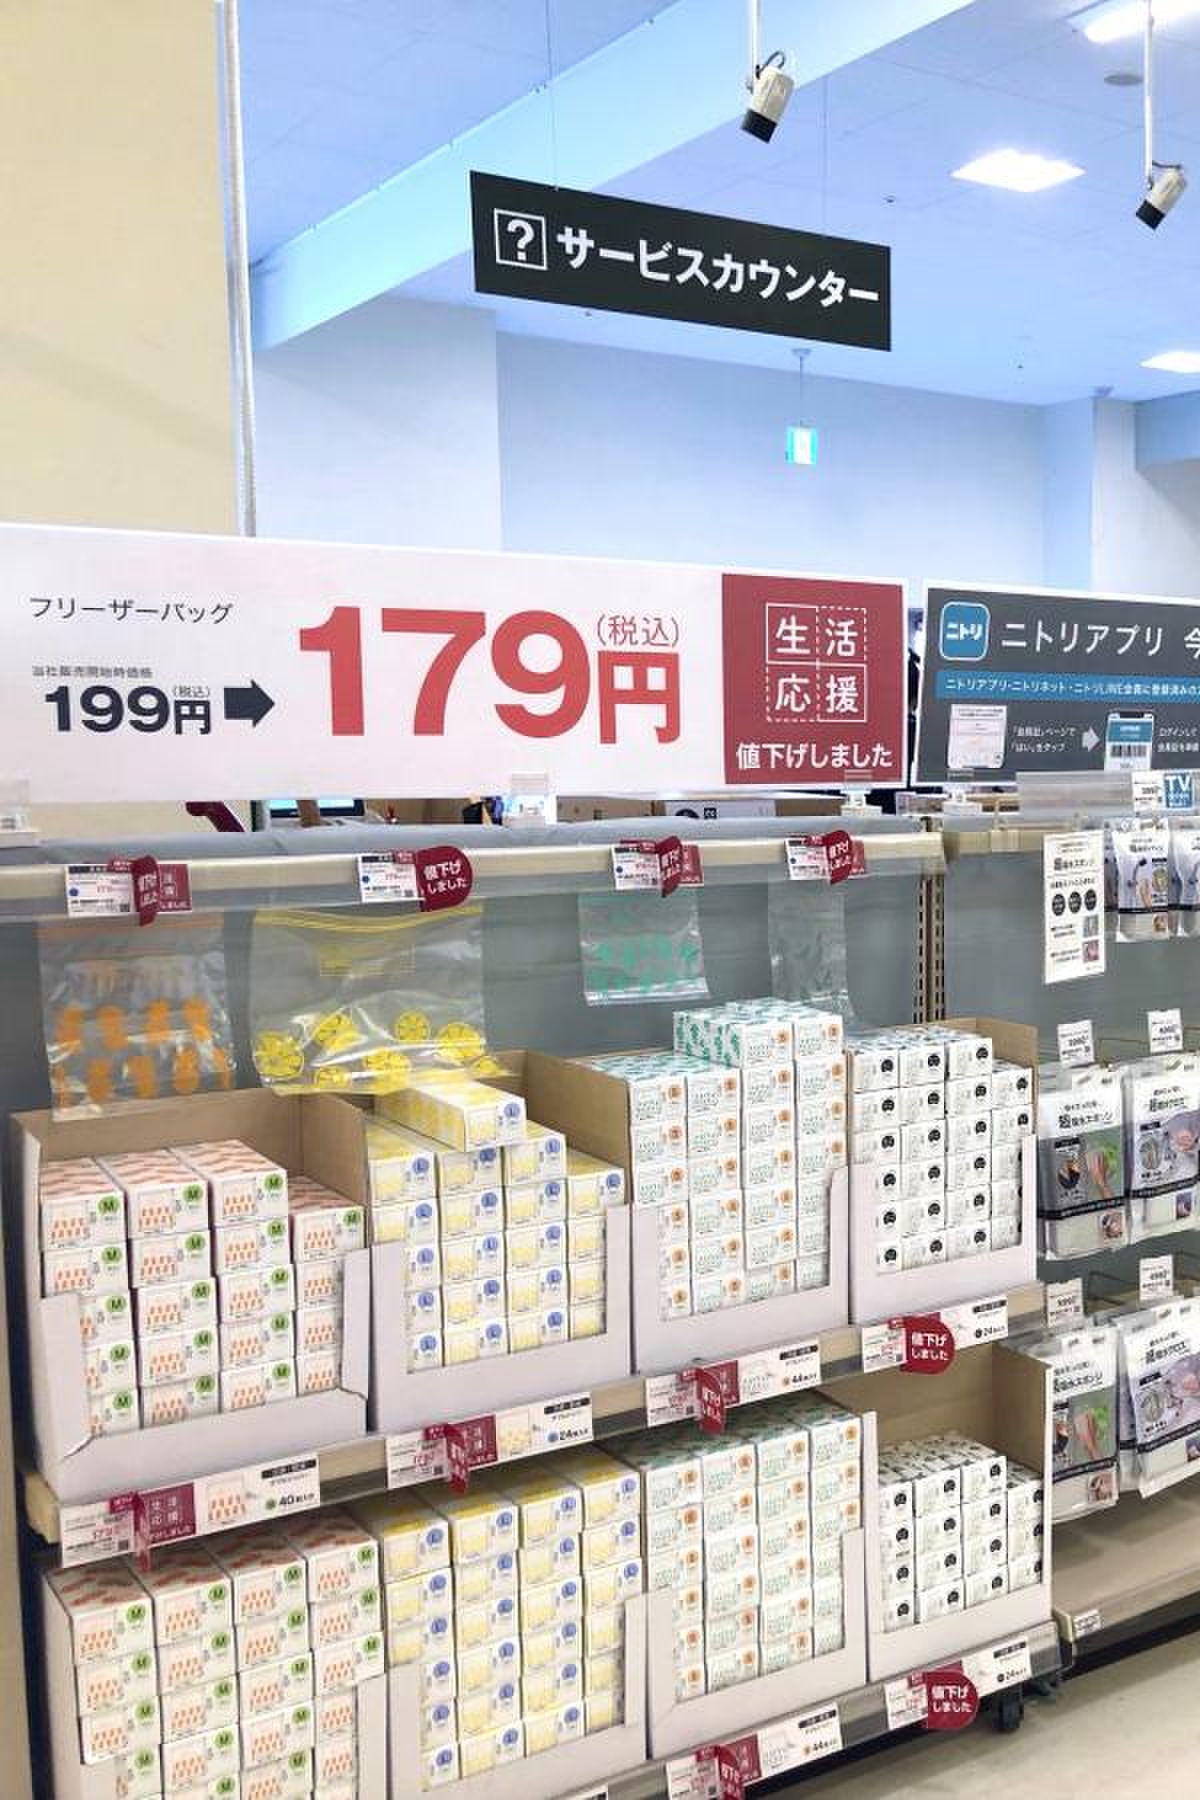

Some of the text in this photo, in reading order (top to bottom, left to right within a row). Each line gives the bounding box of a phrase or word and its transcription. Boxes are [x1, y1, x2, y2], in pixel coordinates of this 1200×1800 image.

[557, 226, 879, 308] サービスカウンター
[30, 597, 233, 625] フリーザーバッグ
[597, 614, 679, 647] (税込)
[775, 614, 859, 657] 生活
[947, 624, 983, 640] ニトリ
[1002, 620, 1163, 655] ニトリアプリ
[32, 665, 153, 679] 当社販売開始時価格
[172, 685, 211, 698] (税込)
[775, 672, 859, 714] 応援
[735, 742, 893, 771] 値下げしました
[1164, 775, 1190, 792] TV
